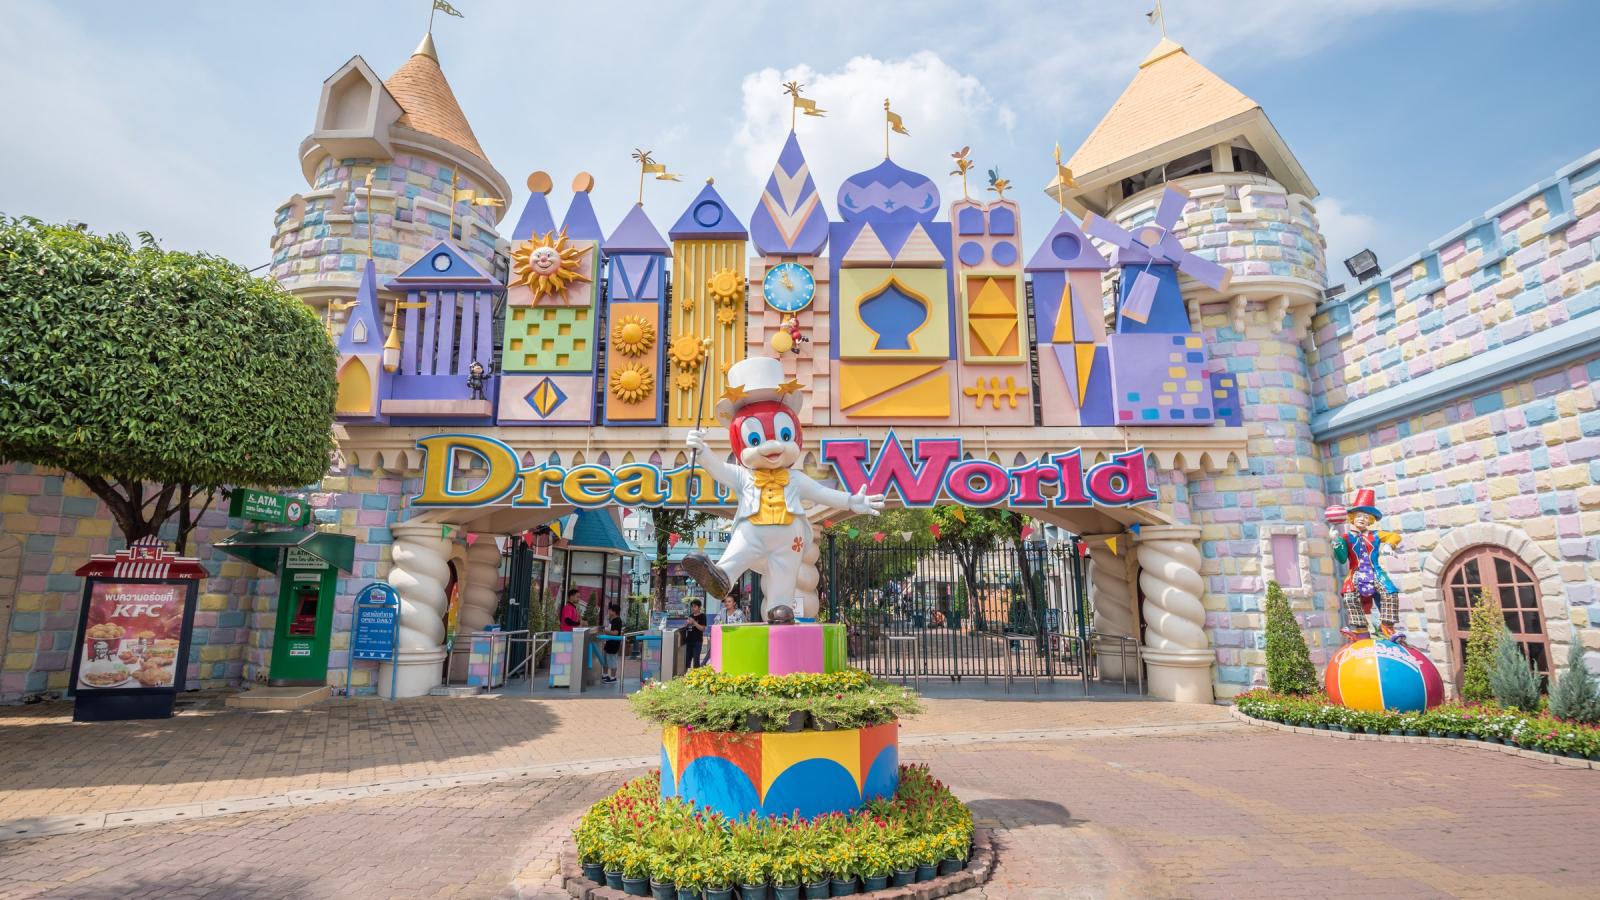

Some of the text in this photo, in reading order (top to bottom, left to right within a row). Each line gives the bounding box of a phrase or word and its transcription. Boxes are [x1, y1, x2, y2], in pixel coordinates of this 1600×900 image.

[820, 426, 1159, 507] World
[257, 495, 277, 507] ATM
[105, 589, 175, 602] พบความอร่อยที่
[111, 604, 163, 617] KFC
